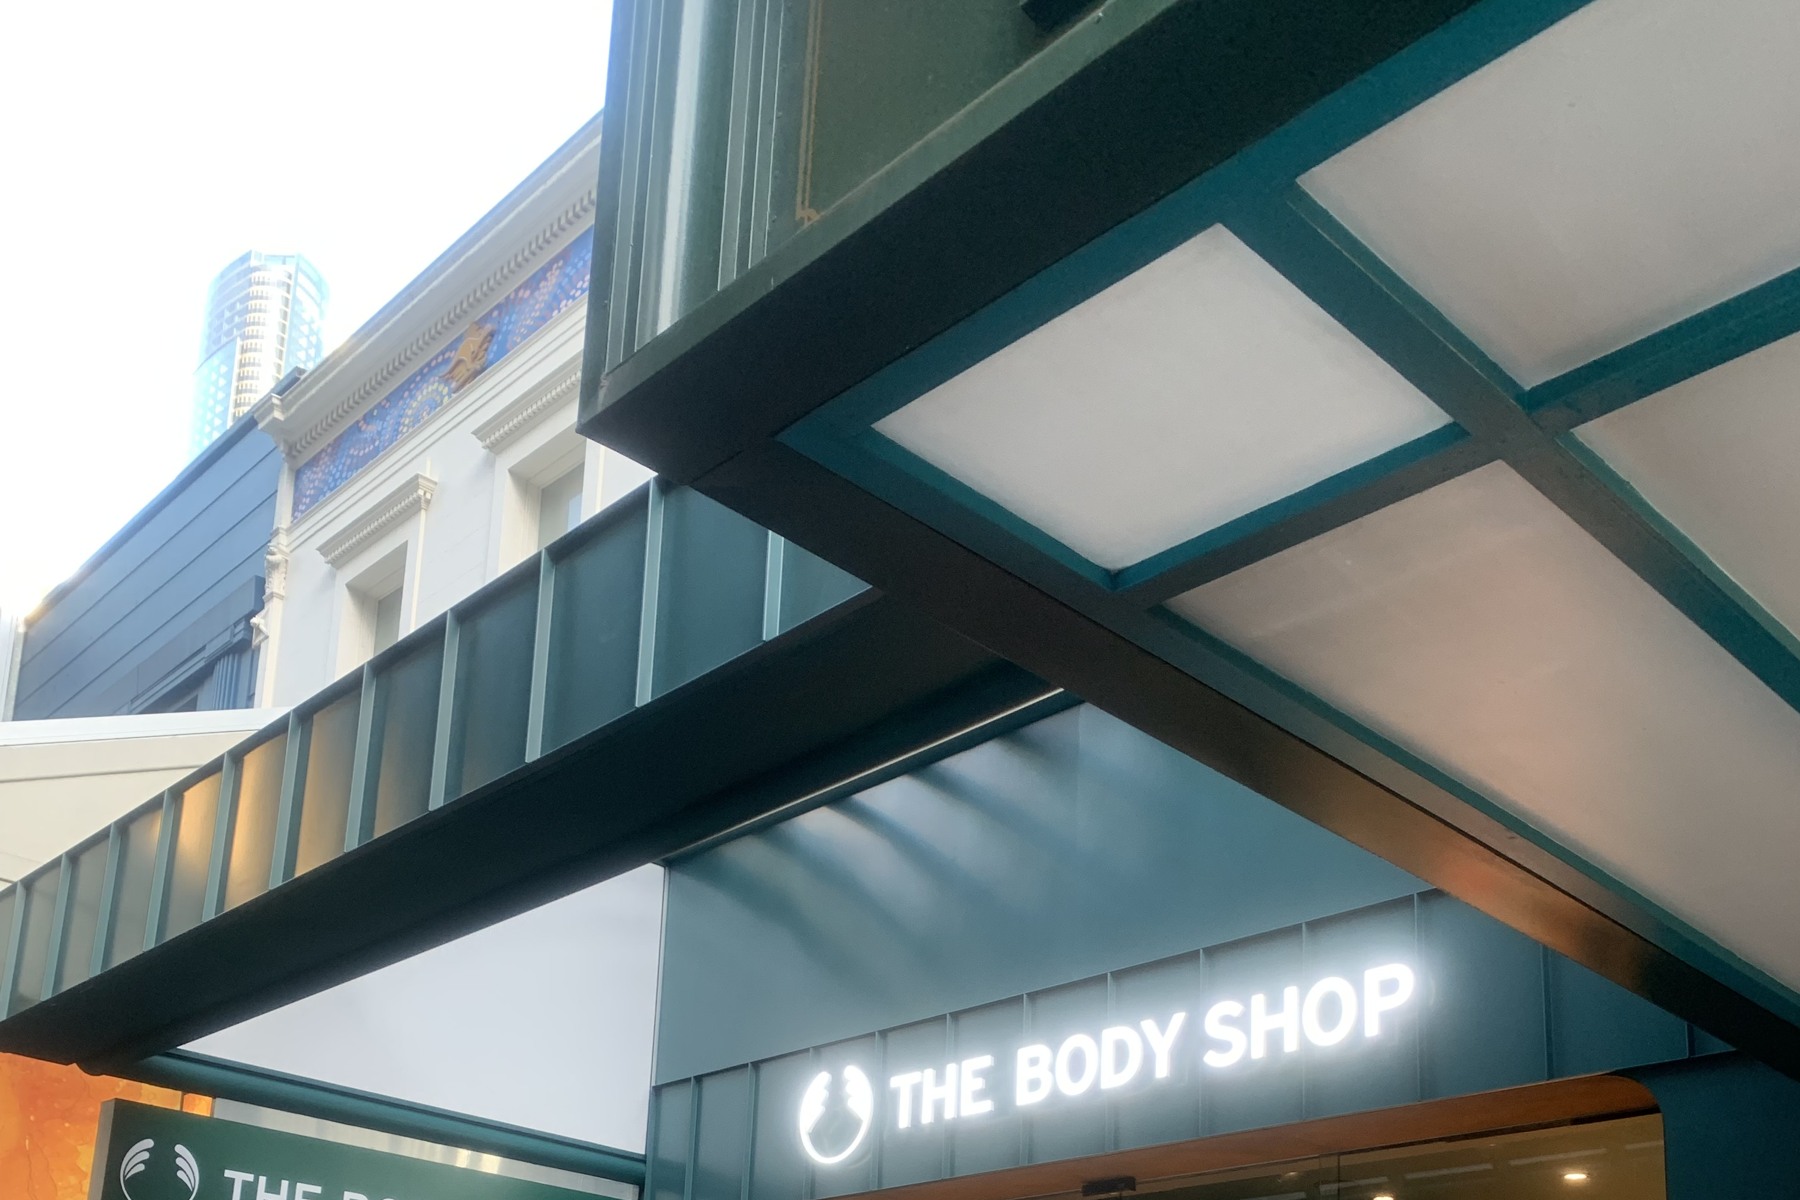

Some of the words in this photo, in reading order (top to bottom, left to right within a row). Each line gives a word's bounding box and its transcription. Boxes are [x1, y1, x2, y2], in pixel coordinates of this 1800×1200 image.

[890, 1054, 995, 1129] THE
[1015, 1011, 1188, 1107] BODY
[1202, 962, 1415, 1068] SHOP
